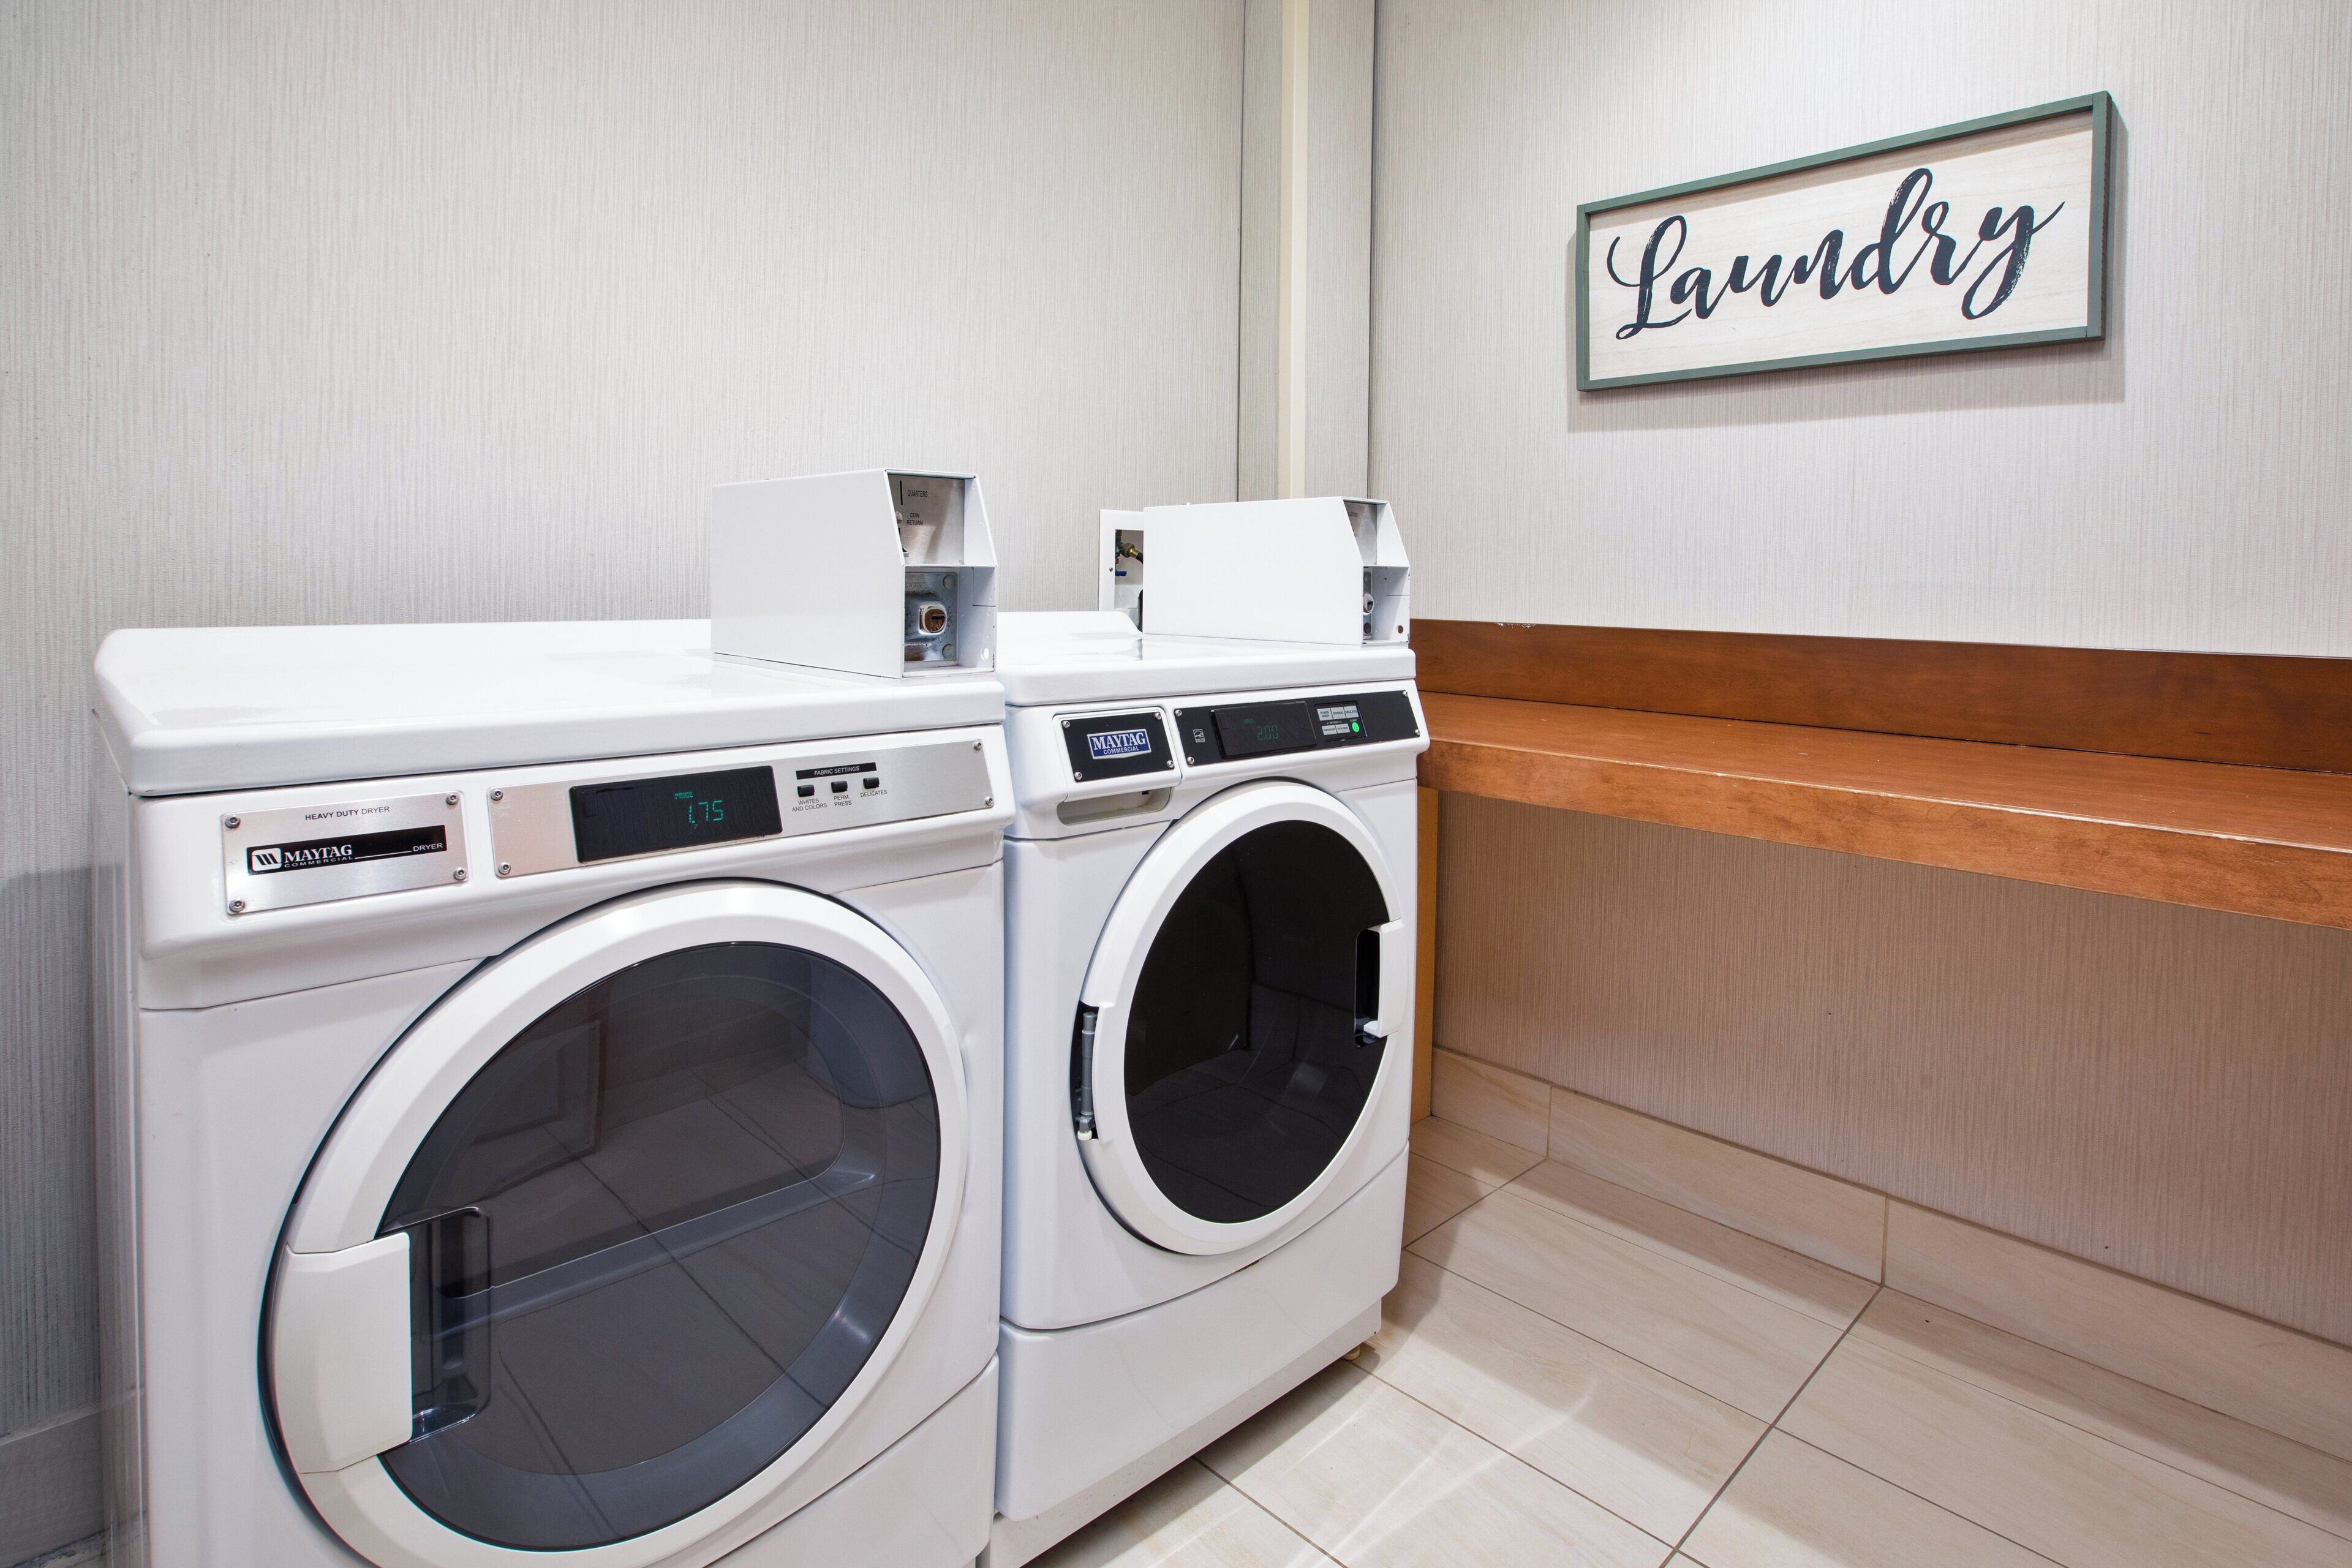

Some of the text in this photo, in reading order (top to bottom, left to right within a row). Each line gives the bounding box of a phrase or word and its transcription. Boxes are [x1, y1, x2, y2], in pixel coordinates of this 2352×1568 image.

[1607, 168, 2065, 340] Laundry
[1091, 732, 1145, 750] MAYTAG
[1103, 745, 1139, 755] COMMERCIAL
[305, 806, 390, 821] HEAVY DUTY DRYER
[688, 799, 723, 824] 1.75
[804, 802, 827, 811] COLORS
[284, 844, 353, 864] MAYTAG
[413, 842, 443, 852] DRYER
[284, 856, 354, 869] COMMERCIAL
